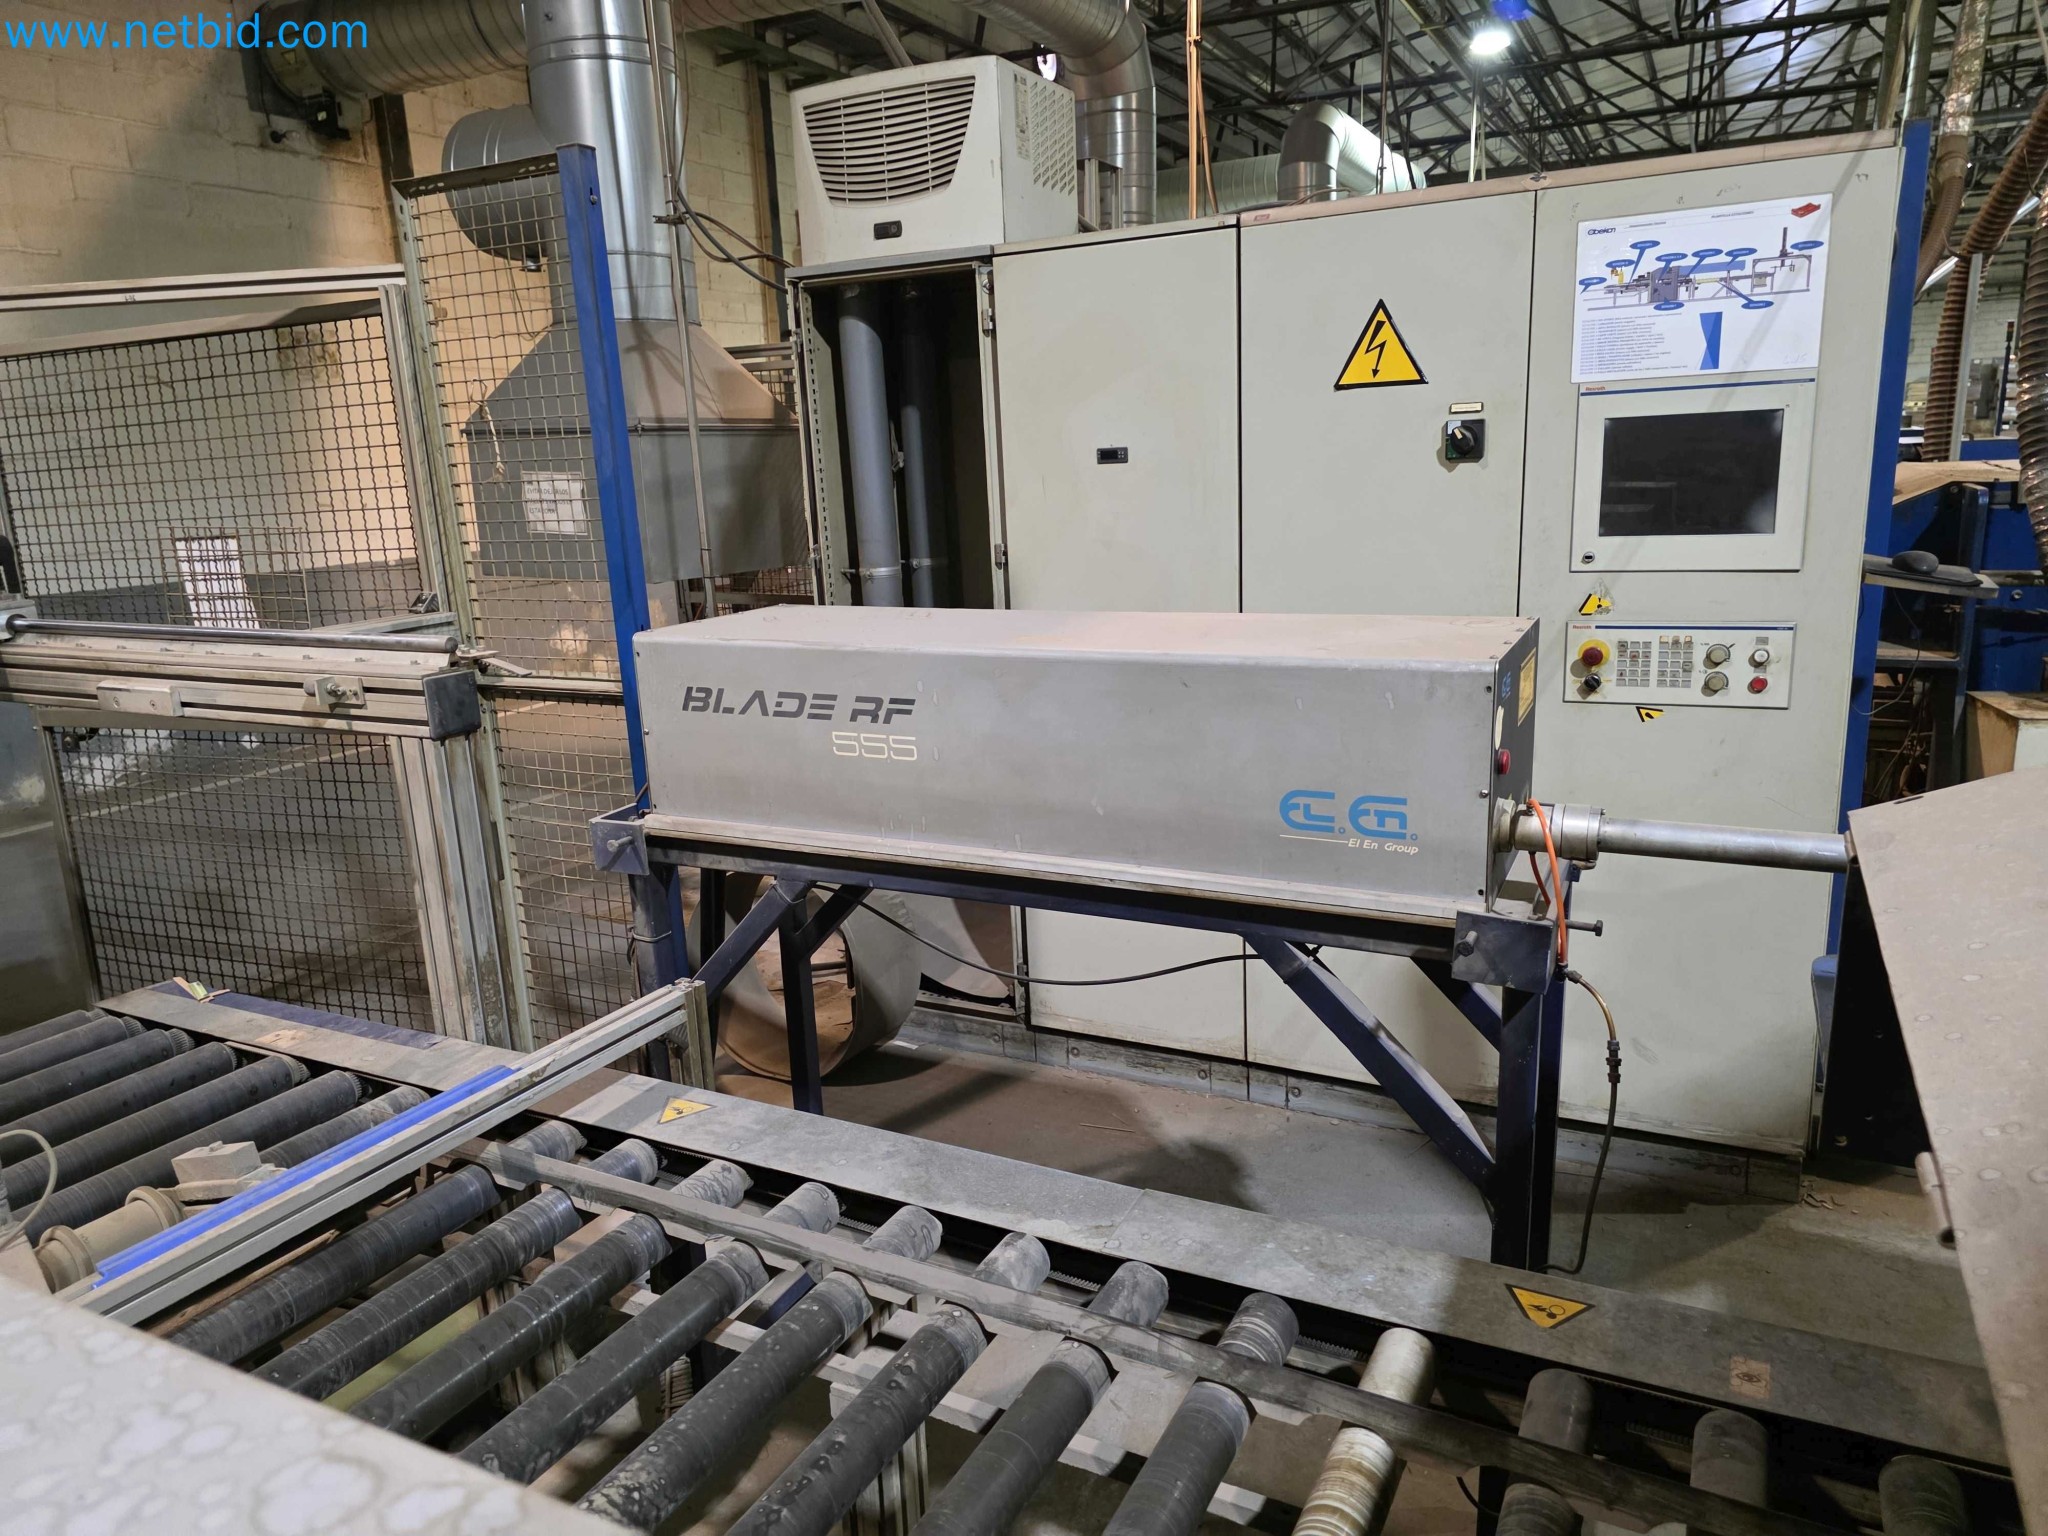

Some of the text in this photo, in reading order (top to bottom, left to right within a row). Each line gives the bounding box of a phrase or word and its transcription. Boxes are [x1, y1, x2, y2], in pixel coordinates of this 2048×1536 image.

[681, 686, 917, 725] BLADE RF
[832, 731, 918, 761] 555
[1363, 839, 1378, 850] En
[1384, 842, 1419, 856] Group
